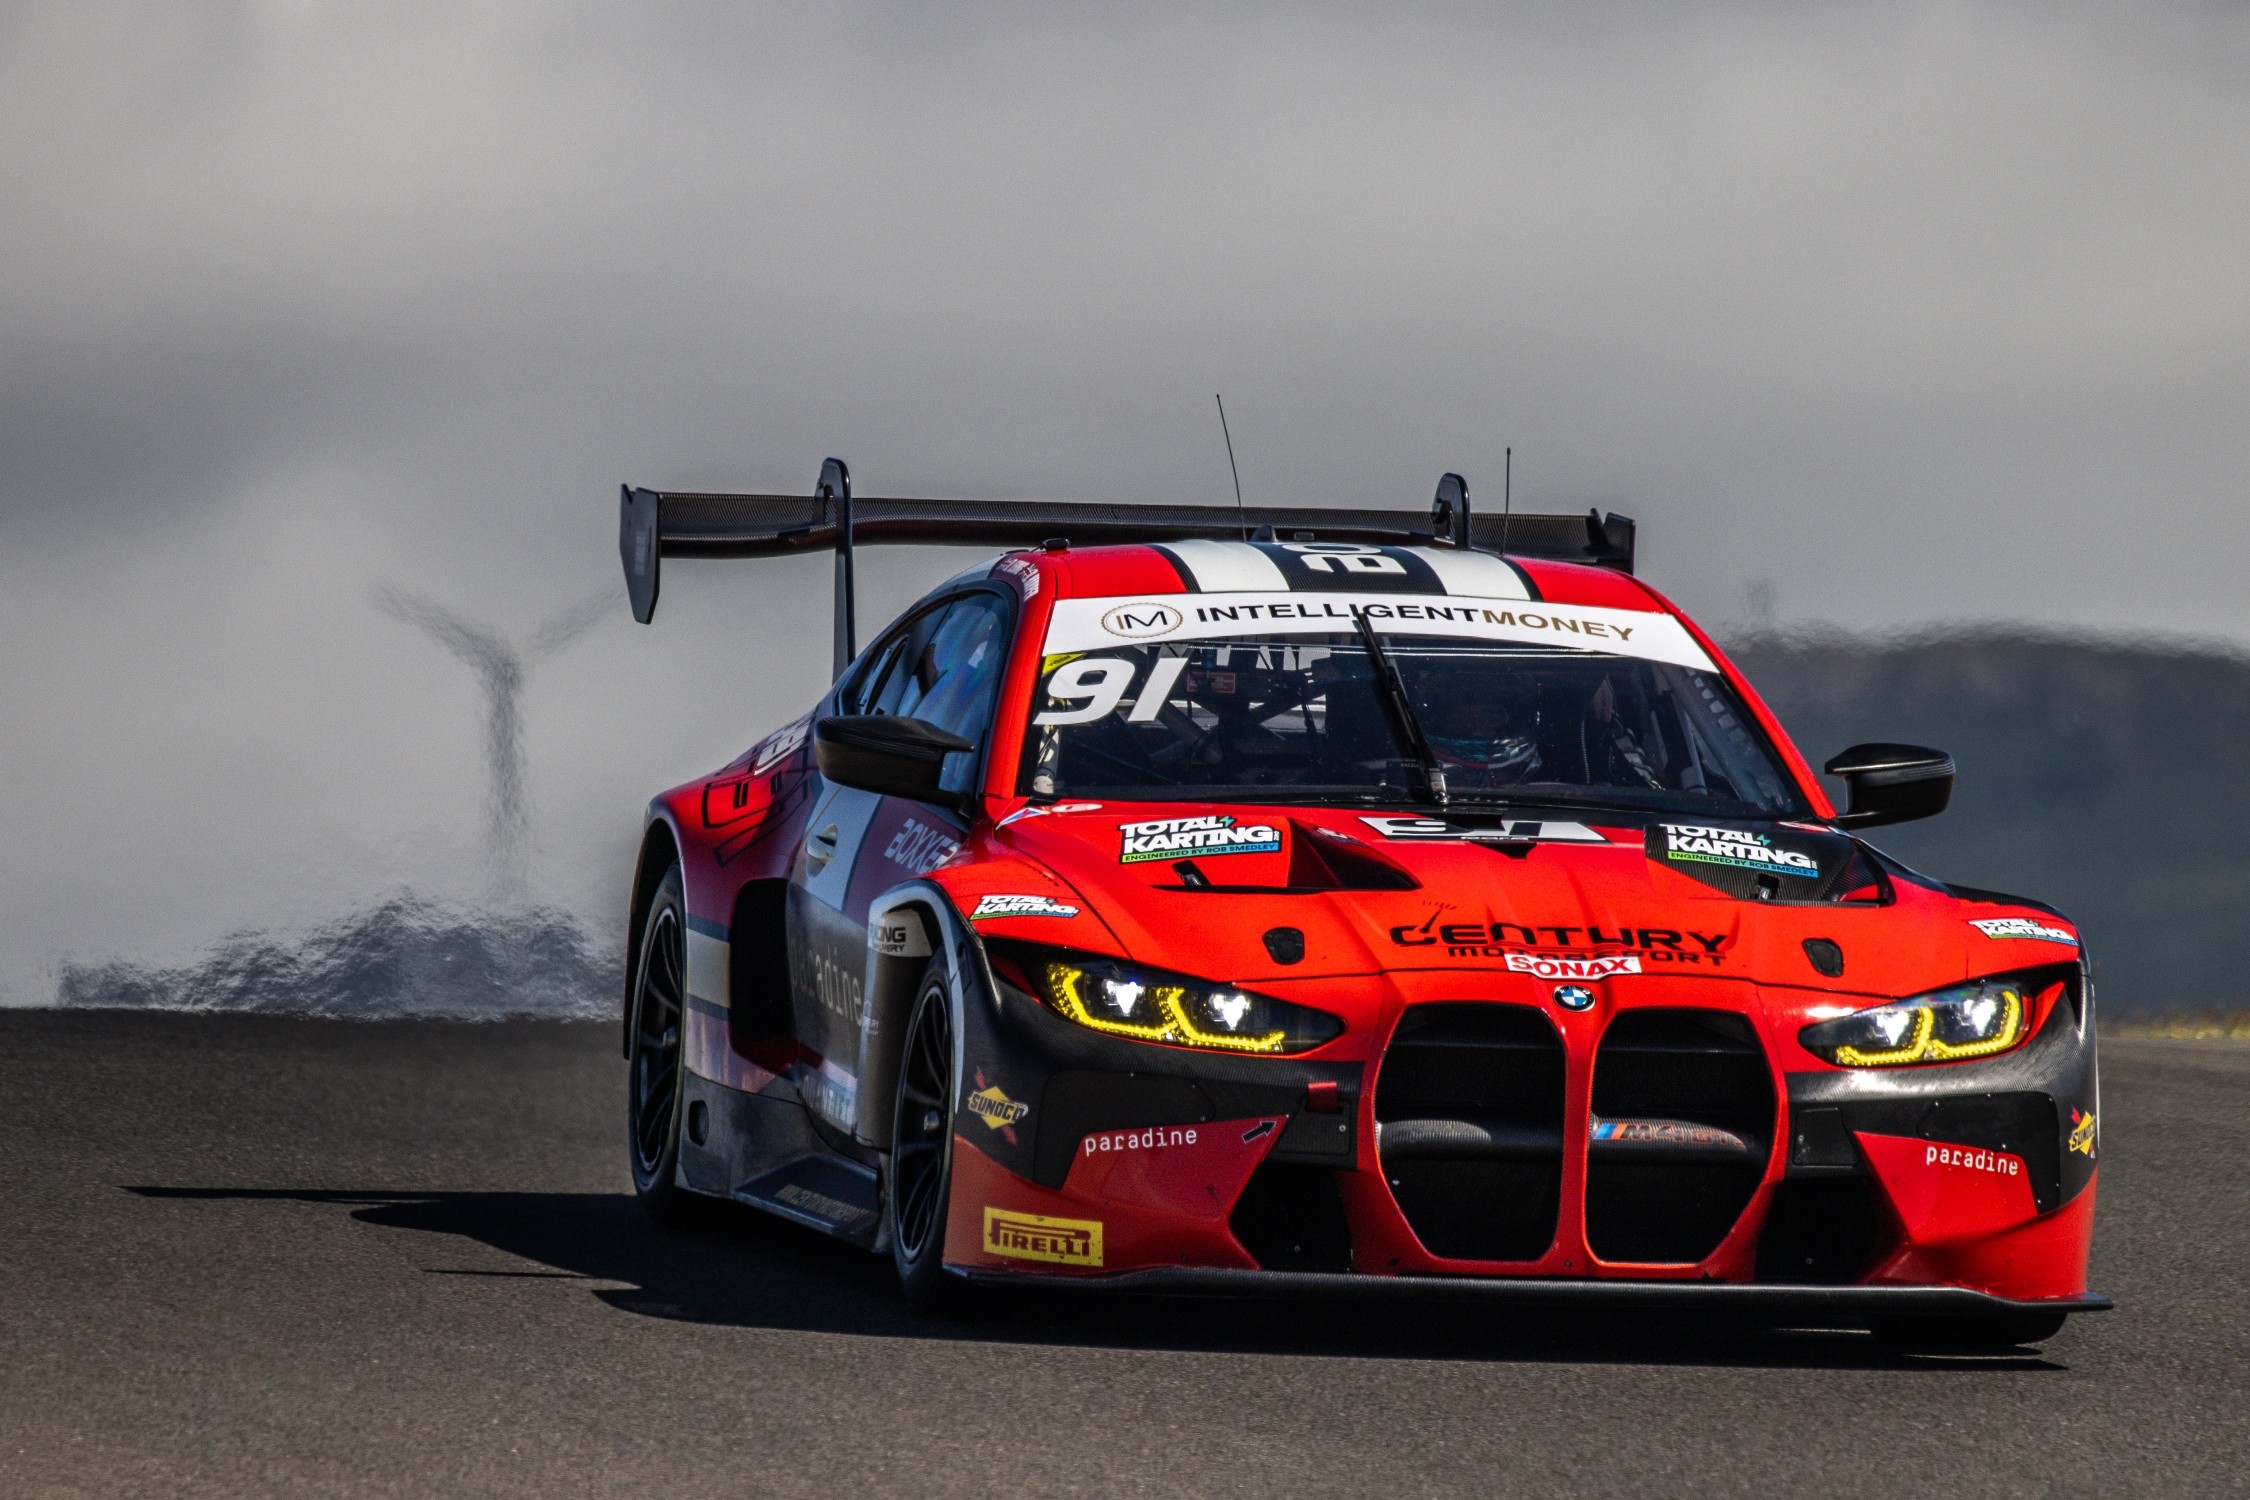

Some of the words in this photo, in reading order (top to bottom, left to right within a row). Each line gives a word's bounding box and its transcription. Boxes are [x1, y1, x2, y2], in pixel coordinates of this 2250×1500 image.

[1116, 610, 1168, 629] IM
[1032, 657, 1189, 725] 91
[1120, 816, 1223, 837] TOTAL
[1659, 823, 1760, 845] TOTAL
[1124, 826, 1273, 853] KARTING
[1125, 850, 1189, 861] ENGINEERED
[1206, 846, 1227, 854] ROB
[1229, 843, 1276, 852] SMEDLEY
[1668, 835, 1811, 869] KARTING
[1671, 852, 1732, 864] ENGINEERED
[1749, 861, 1770, 869] ROB
[1771, 863, 1815, 876] SMEDLEY
[974, 902, 1076, 914] KARTING
[981, 895, 1047, 904] TOTAL
[1968, 918, 2037, 928] TOTAL
[1981, 926, 2075, 941] KARTING
[1390, 921, 1729, 953] CENTURY
[1510, 956, 1633, 977] SONAX
[970, 1092, 1026, 1122] SUNOCO
[1085, 1127, 1197, 1157] paradine
[1926, 1146, 2018, 1176] paradine
[991, 1217, 1091, 1257] PIRELLI
